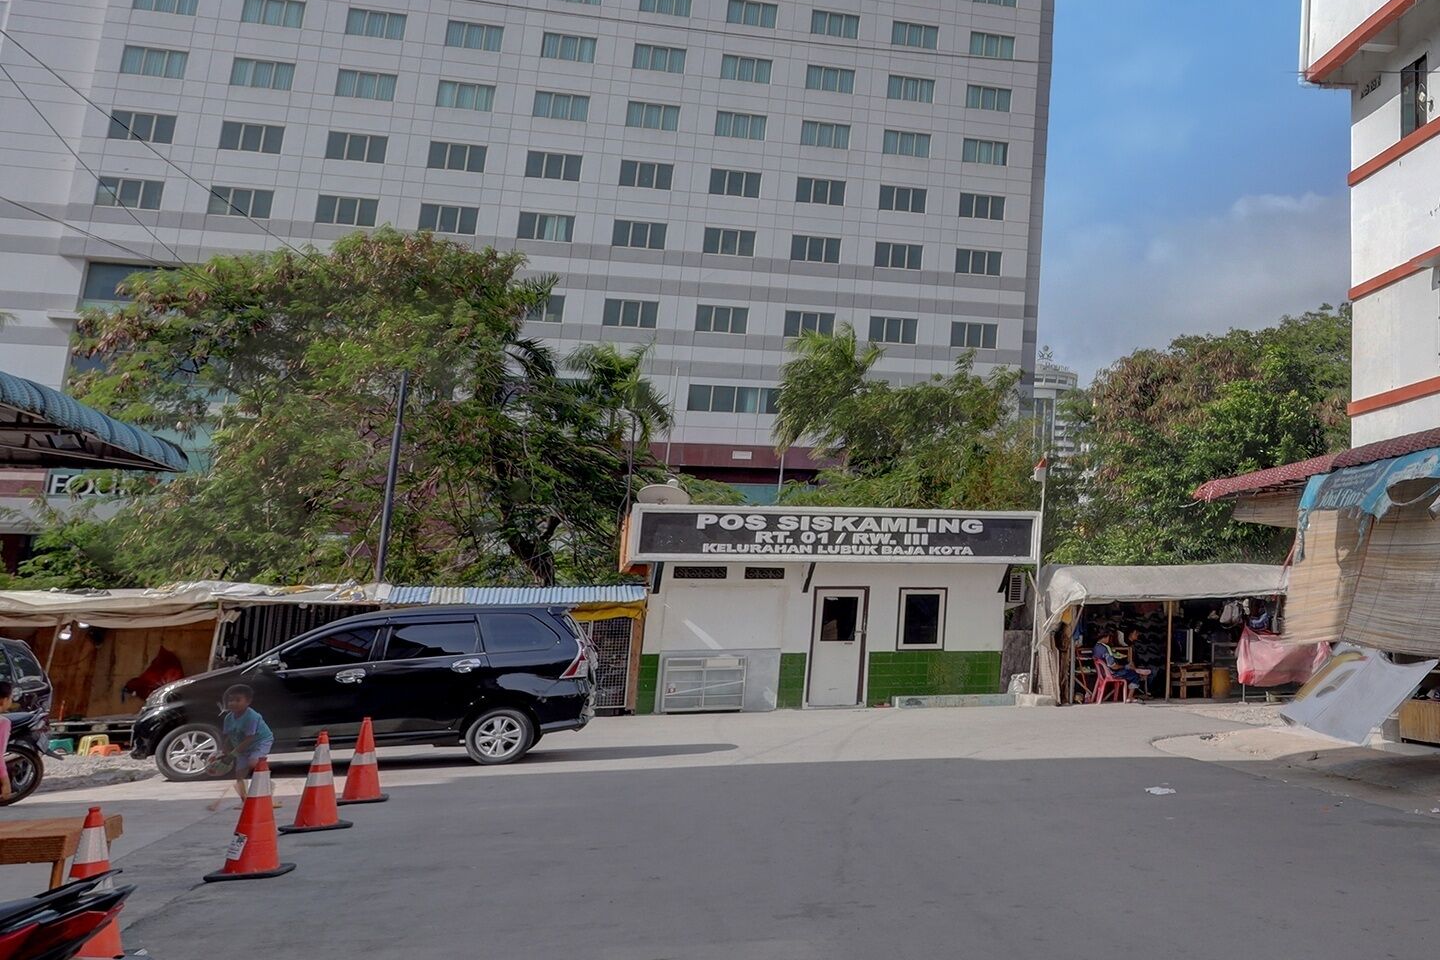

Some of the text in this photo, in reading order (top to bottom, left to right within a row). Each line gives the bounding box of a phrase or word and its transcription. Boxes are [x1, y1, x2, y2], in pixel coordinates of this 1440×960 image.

[696, 513, 984, 534] POS SISKAMLING
[755, 531, 793, 544] RT.
[800, 531, 829, 544] 01
[852, 532, 897, 546] RW.
[904, 533, 929, 546] III
[702, 543, 974, 556] KELURAHAN LUBUK BAJA KOTA
